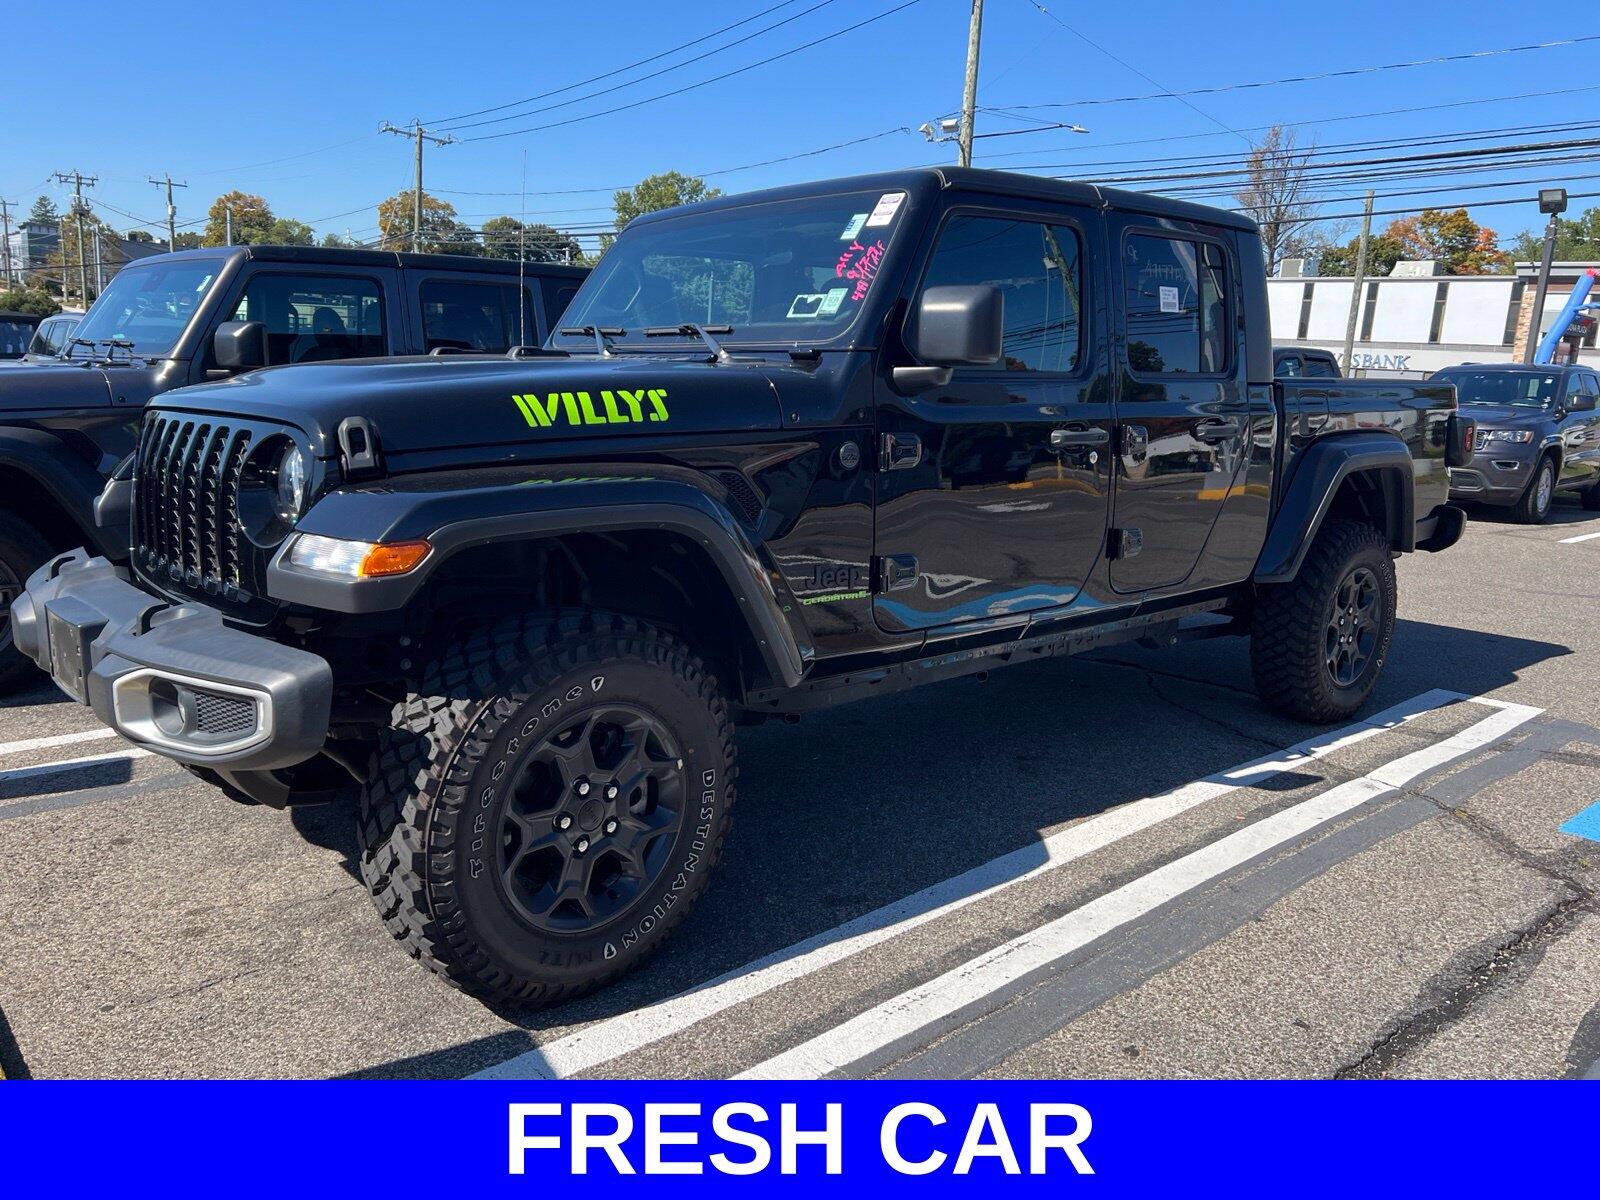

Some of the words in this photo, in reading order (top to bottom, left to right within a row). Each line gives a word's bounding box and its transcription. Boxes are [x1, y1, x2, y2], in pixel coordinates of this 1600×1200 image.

[511, 389, 669, 427] WILLYS
[804, 564, 860, 590] Jeep
[468, 686, 584, 879] Firestone
[622, 769, 716, 950] DESTINATION
